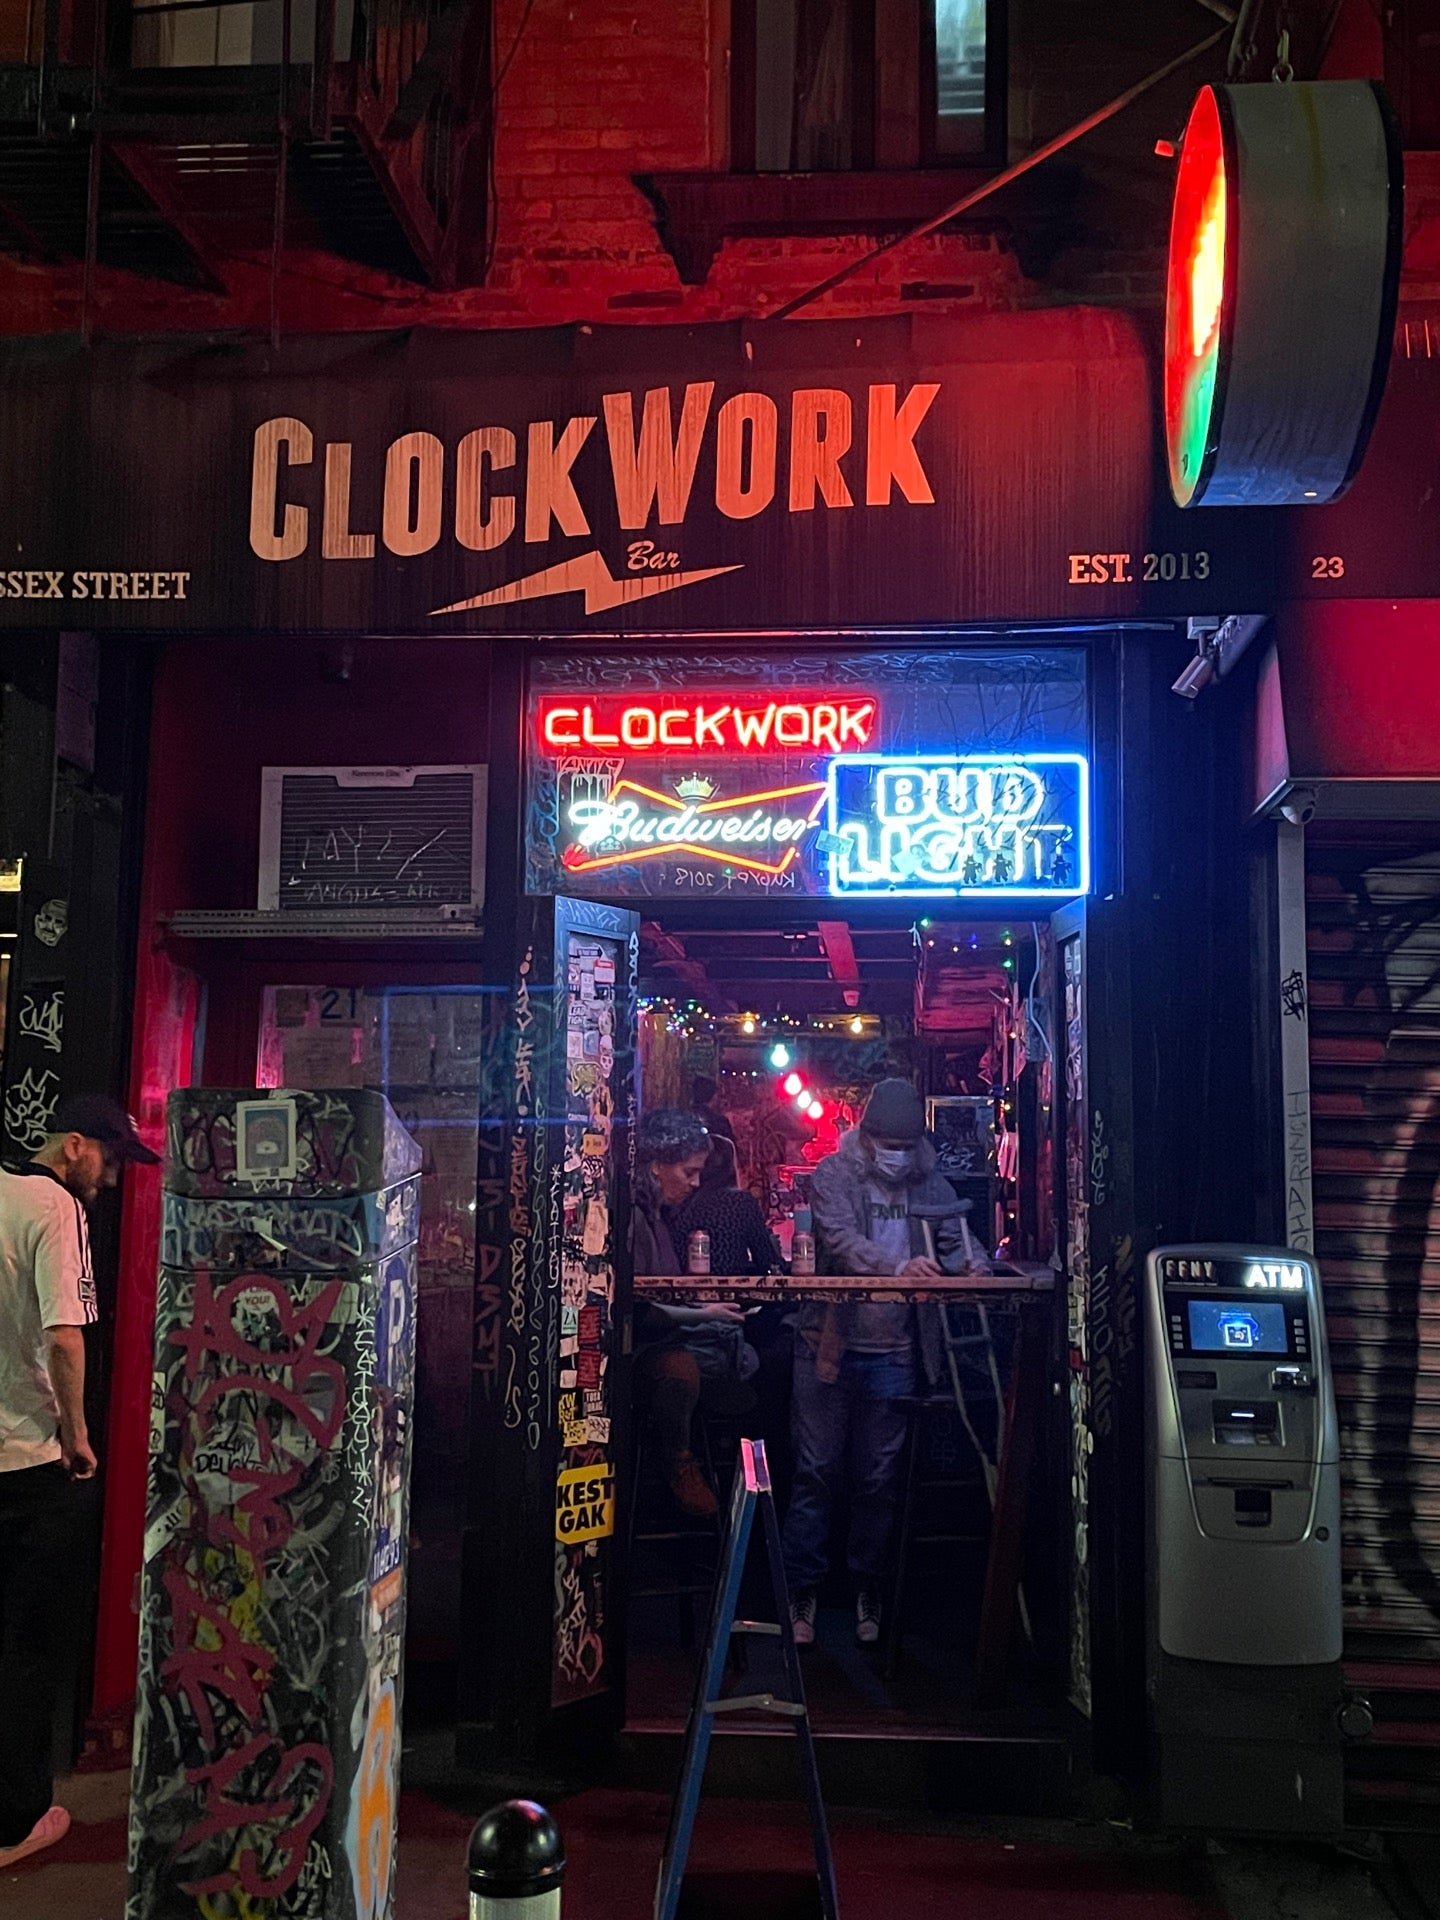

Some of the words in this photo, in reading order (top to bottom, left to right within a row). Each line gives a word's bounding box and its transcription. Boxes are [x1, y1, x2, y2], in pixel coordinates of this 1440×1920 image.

[248, 380, 941, 562] CLOCKWORK
[627, 541, 681, 572] Bar
[1069, 554, 1133, 584] EST.
[1142, 551, 1212, 582] 2013
[1311, 556, 1346, 580] 23
[72, 571, 191, 601] STREET
[543, 703, 874, 752] CLOCKWORK
[879, 767, 1044, 825] BUD
[568, 800, 820, 845] Budweiser
[838, 822, 1074, 883] LIGHT
[320, 988, 357, 1019] 21
[1245, 1264, 1303, 1289] ATM
[557, 1476, 616, 1509] KEST
[557, 1502, 606, 1534] GAK
